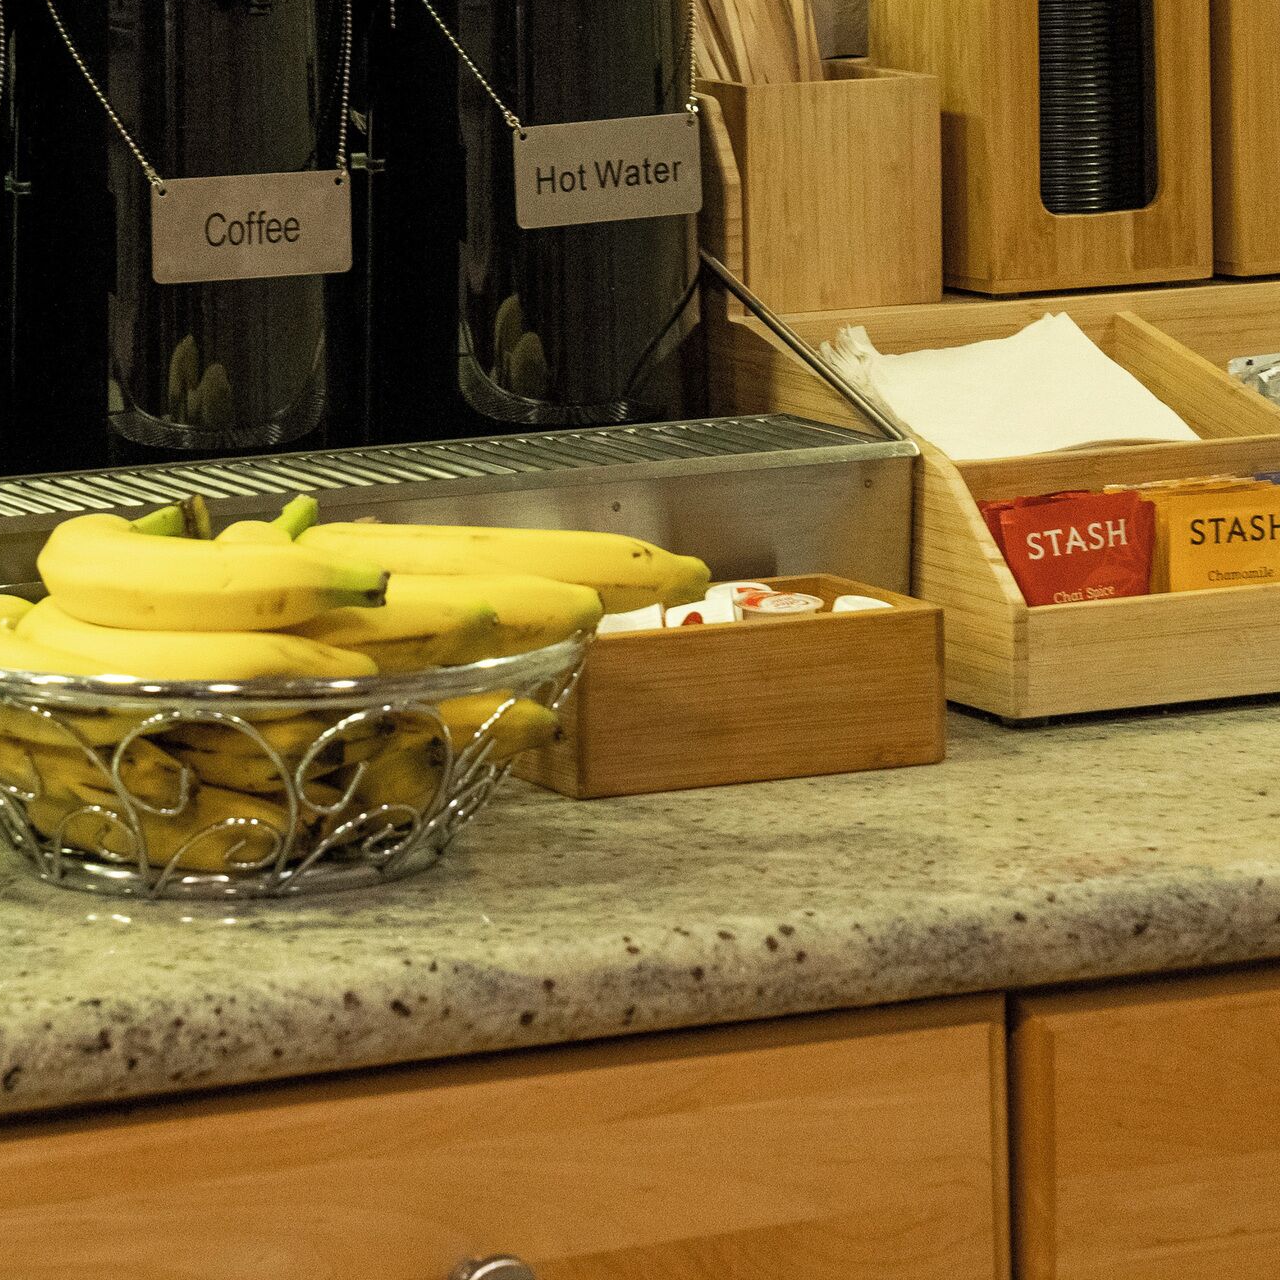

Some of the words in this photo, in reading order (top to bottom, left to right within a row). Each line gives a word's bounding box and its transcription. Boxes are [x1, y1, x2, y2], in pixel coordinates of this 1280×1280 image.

[535, 163, 588, 195] Hot
[593, 157, 683, 189] Water
[204, 210, 301, 247] Coffee
[1025, 518, 1129, 561] STASH
[1207, 566, 1276, 582] Chamomile
[1053, 587, 1084, 604] Chai
[1087, 583, 1116, 601] Spice
